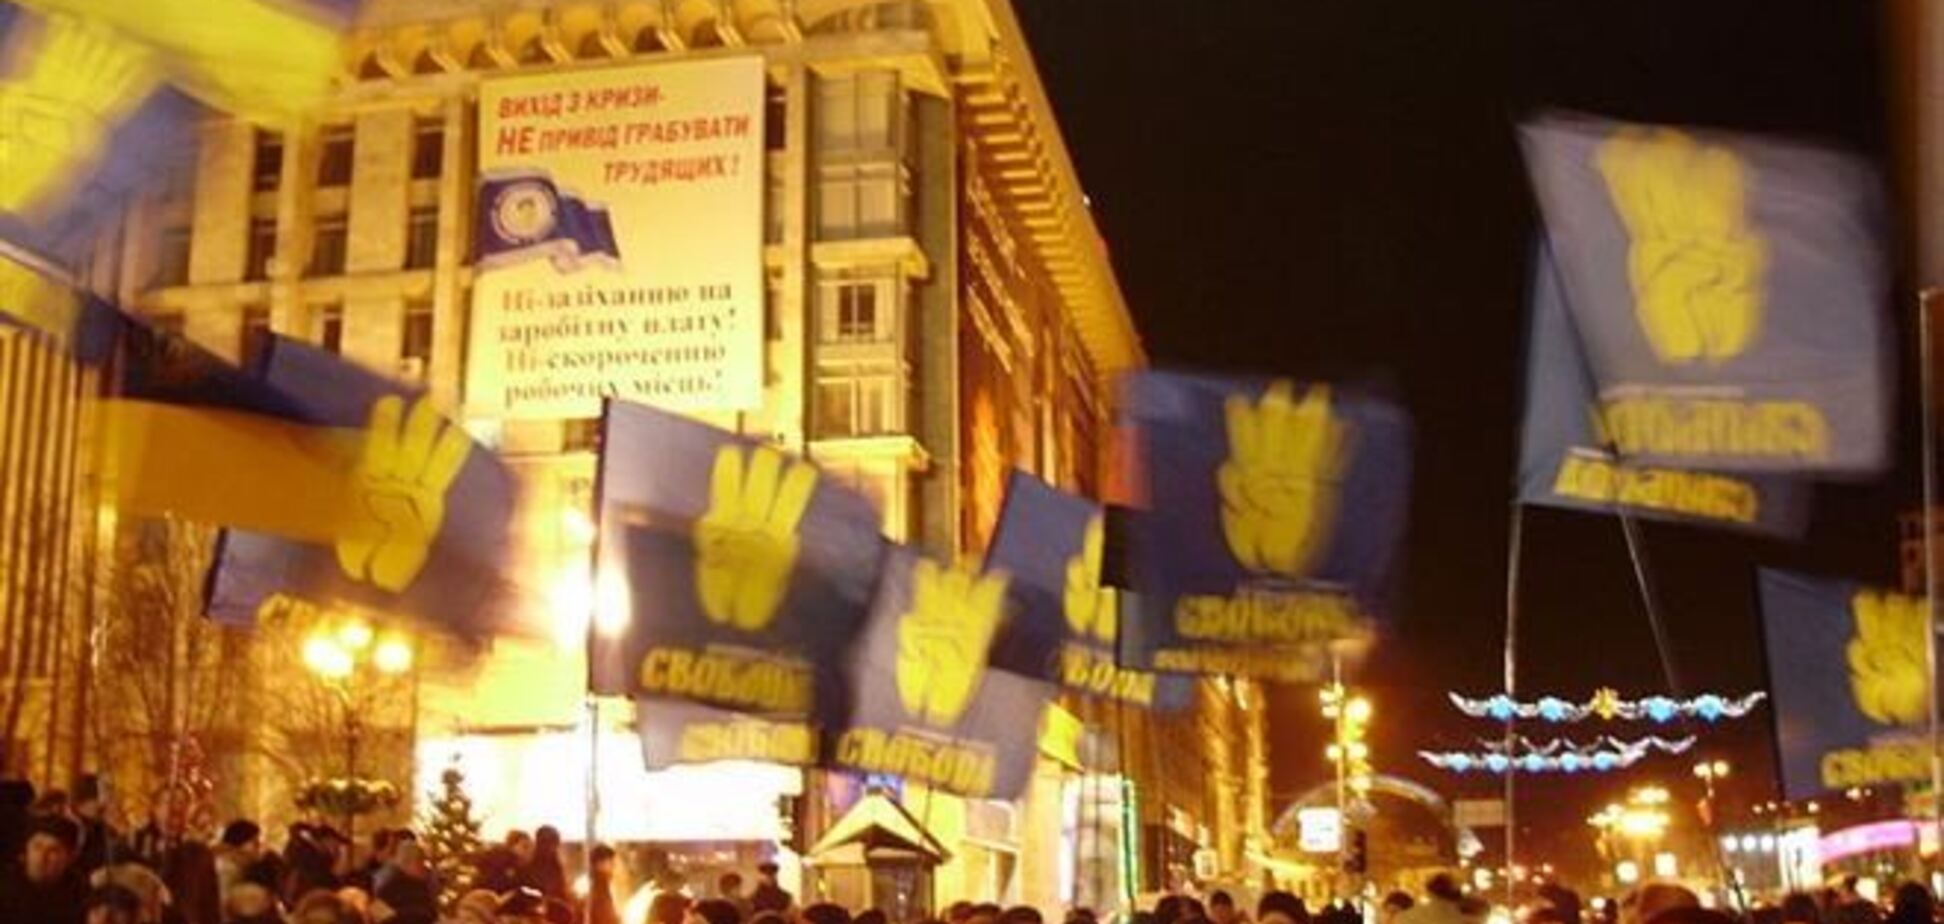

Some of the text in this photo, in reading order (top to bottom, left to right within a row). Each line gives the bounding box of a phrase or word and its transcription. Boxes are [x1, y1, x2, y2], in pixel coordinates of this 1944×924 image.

[497, 94, 561, 119] ВИХІД
[566, 93, 580, 115] З
[496, 113, 751, 155] НЕ ПРИВІД ГРАБУВАТИ
